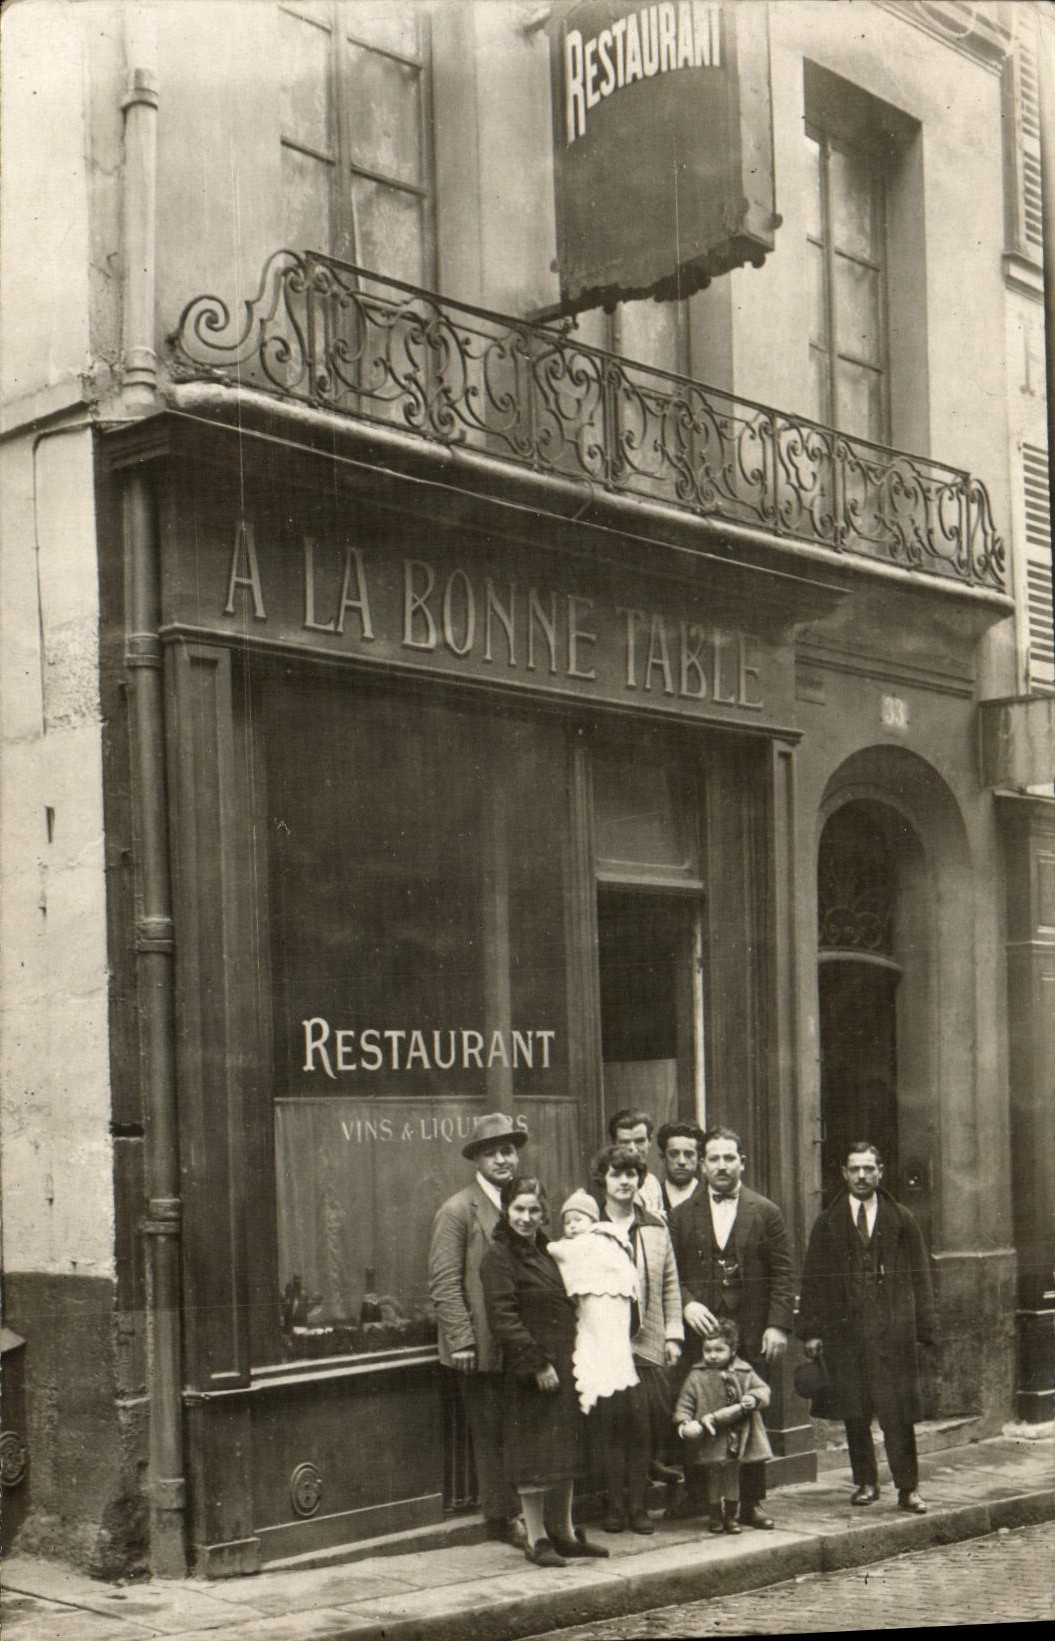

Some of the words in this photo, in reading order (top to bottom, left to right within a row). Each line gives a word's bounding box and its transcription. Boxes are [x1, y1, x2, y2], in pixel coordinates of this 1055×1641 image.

[566, 1, 722, 144] RESTAURANT
[225, 521, 267, 618] A
[304, 537, 374, 639] LA
[402, 558, 597, 679] BONNE
[615, 606, 763, 709] TABLE
[302, 1017, 555, 1079] RESTAURANT
[341, 1119, 393, 1142] VINS
[401, 1123, 414, 1141] &
[420, 1115, 528, 1143] LIQUS
